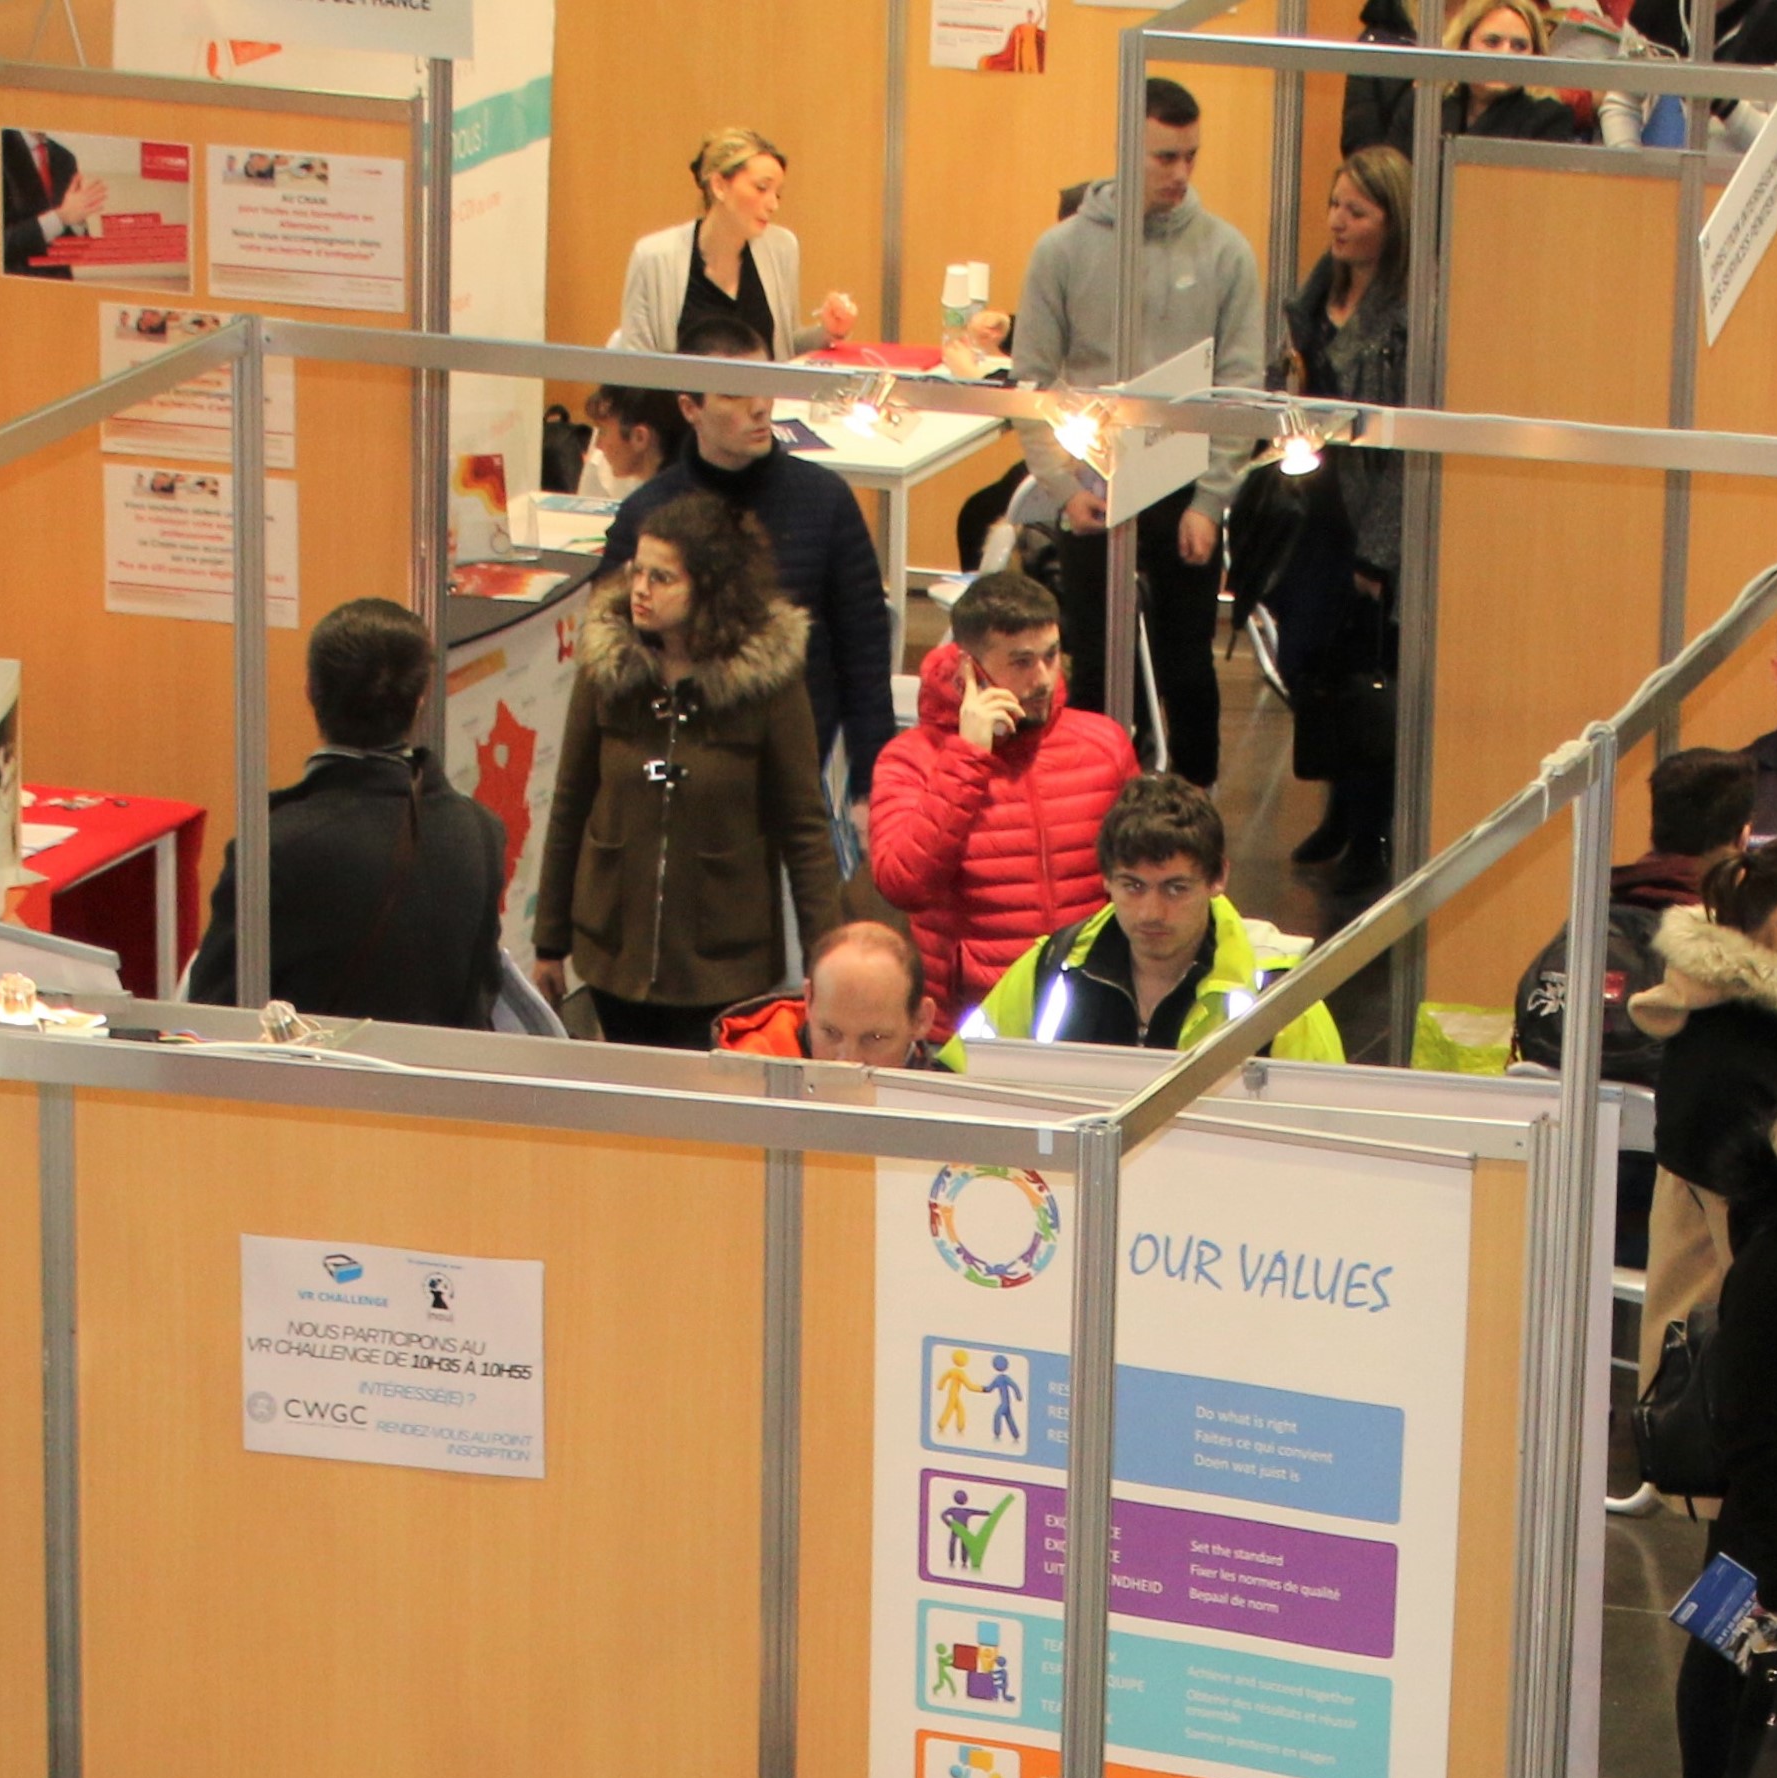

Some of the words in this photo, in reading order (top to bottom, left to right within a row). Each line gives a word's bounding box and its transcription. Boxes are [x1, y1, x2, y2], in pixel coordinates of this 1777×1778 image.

[1129, 1231, 1223, 1291] OUR
[1238, 1242, 1396, 1314] VALUES
[287, 1320, 340, 1341] NOUS
[342, 1325, 457, 1354] PARTICIPONS
[459, 1339, 486, 1356] AU
[247, 1336, 272, 1353] VR
[275, 1339, 382, 1365] CHALLENGE
[384, 1350, 408, 1368] DE
[410, 1353, 461, 1375] 10H35
[481, 1361, 533, 1381] 10H55
[284, 1397, 369, 1425] CWGC
[1195, 1404, 1215, 1420] Do
[1217, 1407, 1252, 1426] what
[1267, 1416, 1299, 1435] right
[1194, 1429, 1234, 1448] Faites
[1190, 1539, 1211, 1556] Set
[1211, 1543, 1232, 1558] the
[1233, 1547, 1285, 1568] standard
